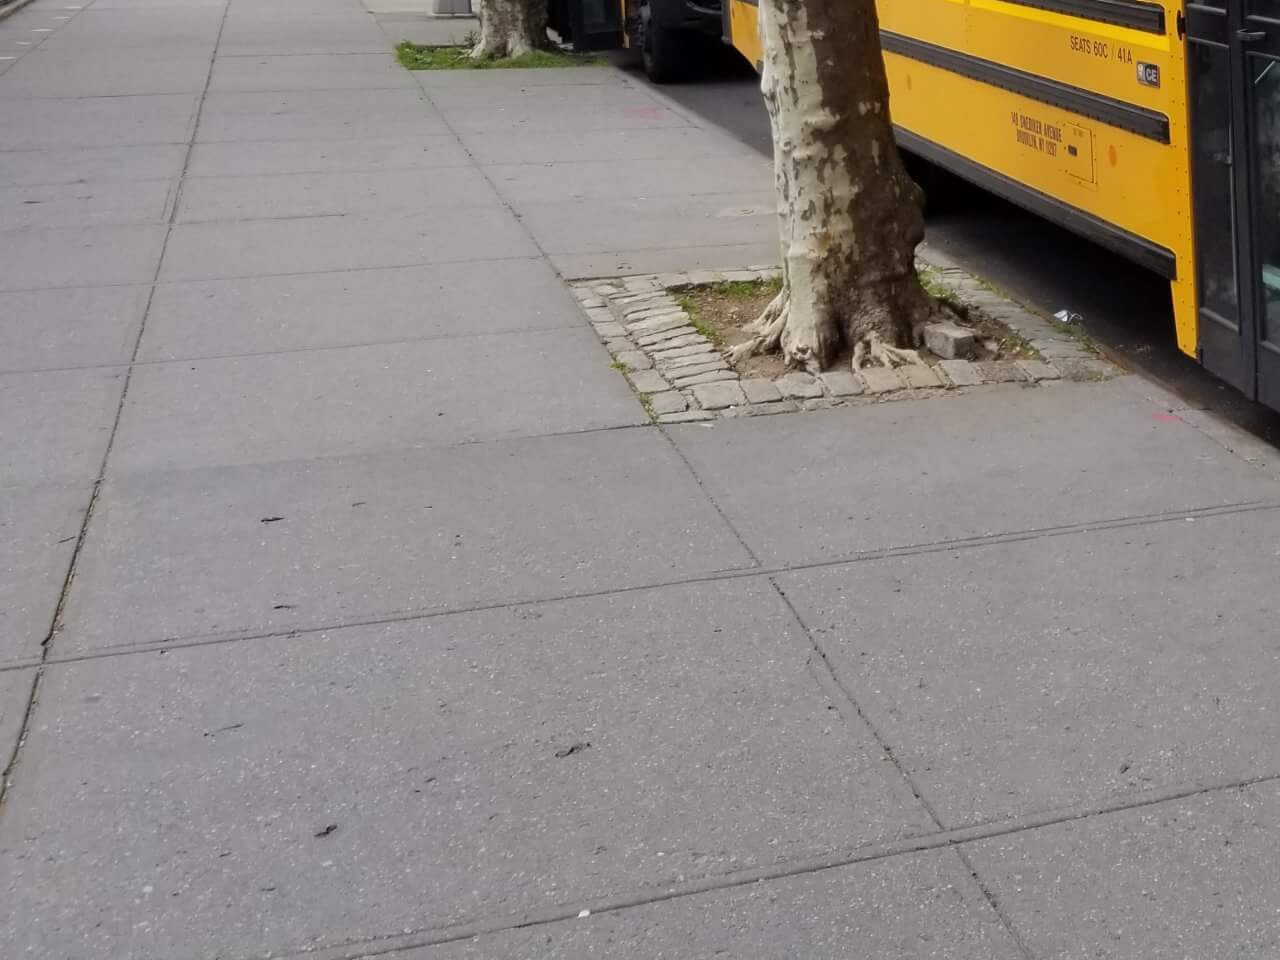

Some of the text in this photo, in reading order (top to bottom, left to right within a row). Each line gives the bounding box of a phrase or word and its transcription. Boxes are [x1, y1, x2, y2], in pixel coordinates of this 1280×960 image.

[1070, 36, 1090, 54] SEATS
[1093, 41, 1108, 58] 60C
[1117, 48, 1133, 64] 41A
